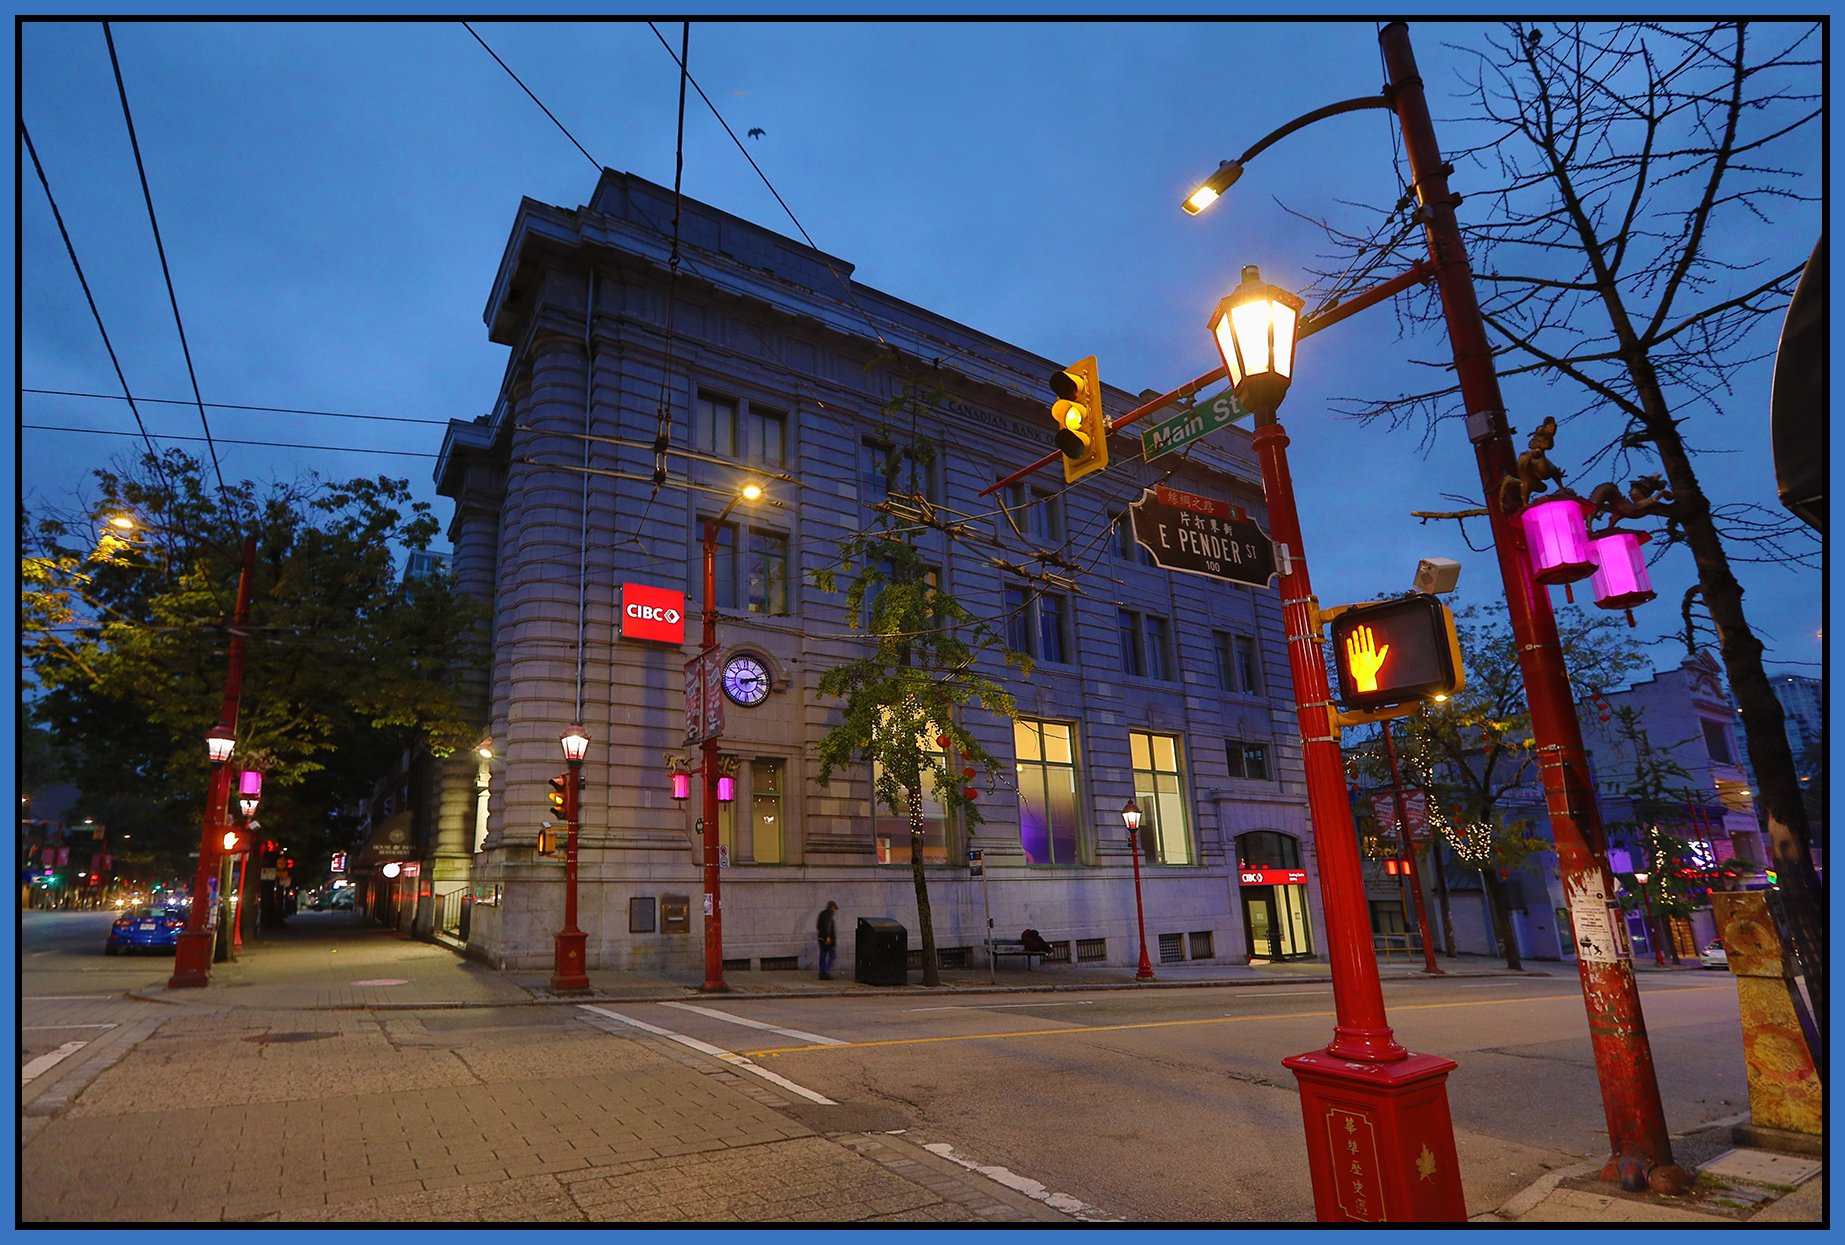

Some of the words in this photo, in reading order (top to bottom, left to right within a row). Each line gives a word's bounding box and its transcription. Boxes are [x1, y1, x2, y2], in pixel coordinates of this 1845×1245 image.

[949, 401, 1008, 428] CANADIAN
[1012, 423, 1041, 441] BANK
[1153, 416, 1204, 448] Main
[1213, 396, 1240, 422] St
[1158, 523, 1170, 549] E
[1178, 528, 1242, 565] PENDER
[1245, 544, 1257, 560] ST
[1206, 560, 1221, 572] 100
[627, 603, 664, 622] CIBC
